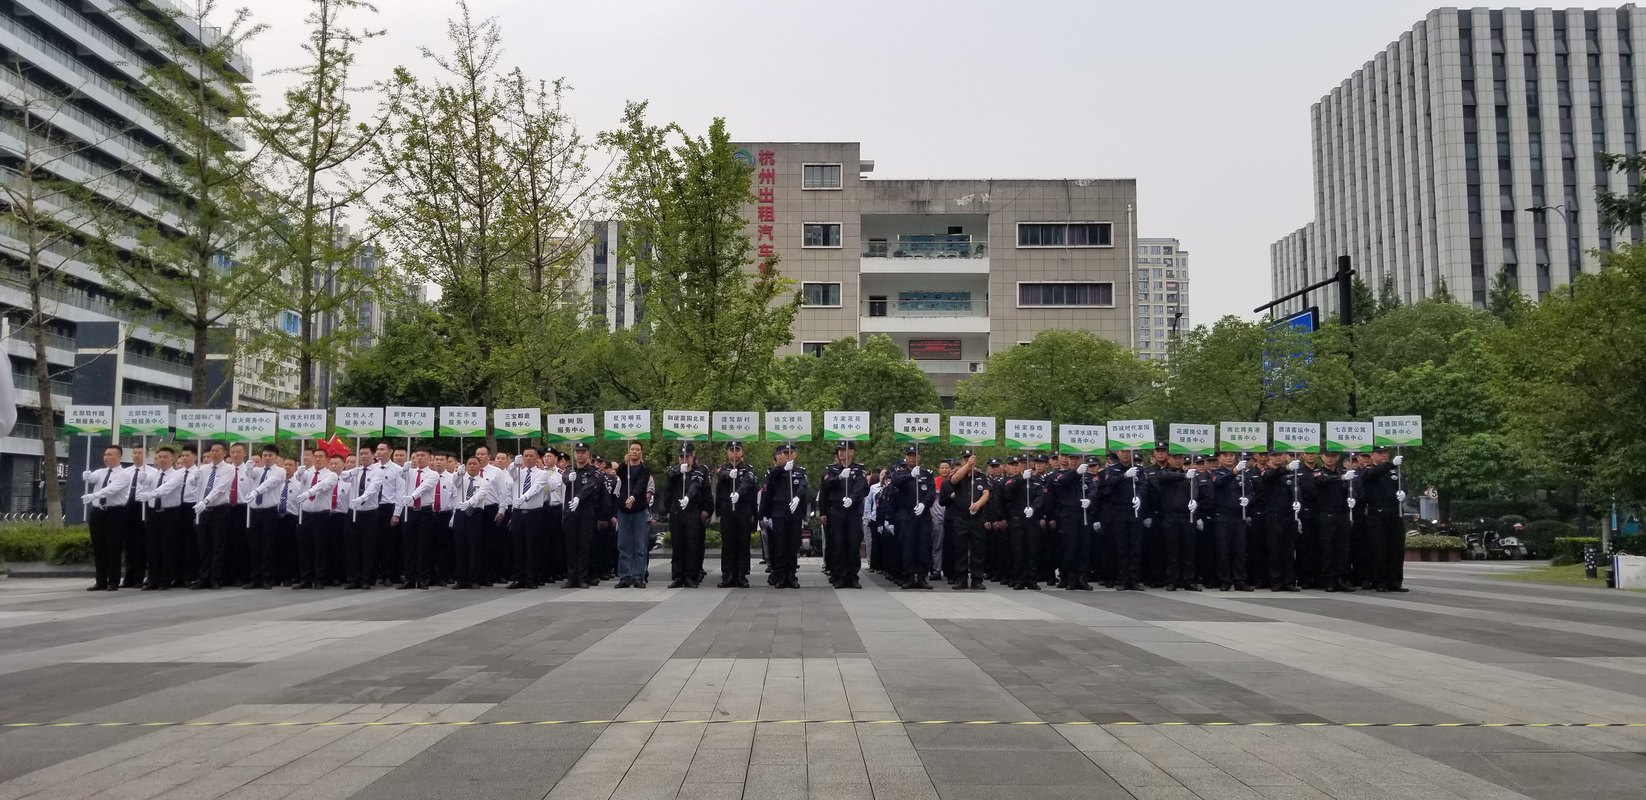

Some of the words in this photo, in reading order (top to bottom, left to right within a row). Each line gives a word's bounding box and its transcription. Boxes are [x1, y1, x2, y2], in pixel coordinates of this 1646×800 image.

[128, 409, 161, 417] 北部软件园
[958, 428, 987, 436] 服务中心
[1112, 424, 1150, 432] 西城时代家园
[1179, 436, 1205, 444] 服务中心
[1284, 434, 1310, 442] 服务中心
